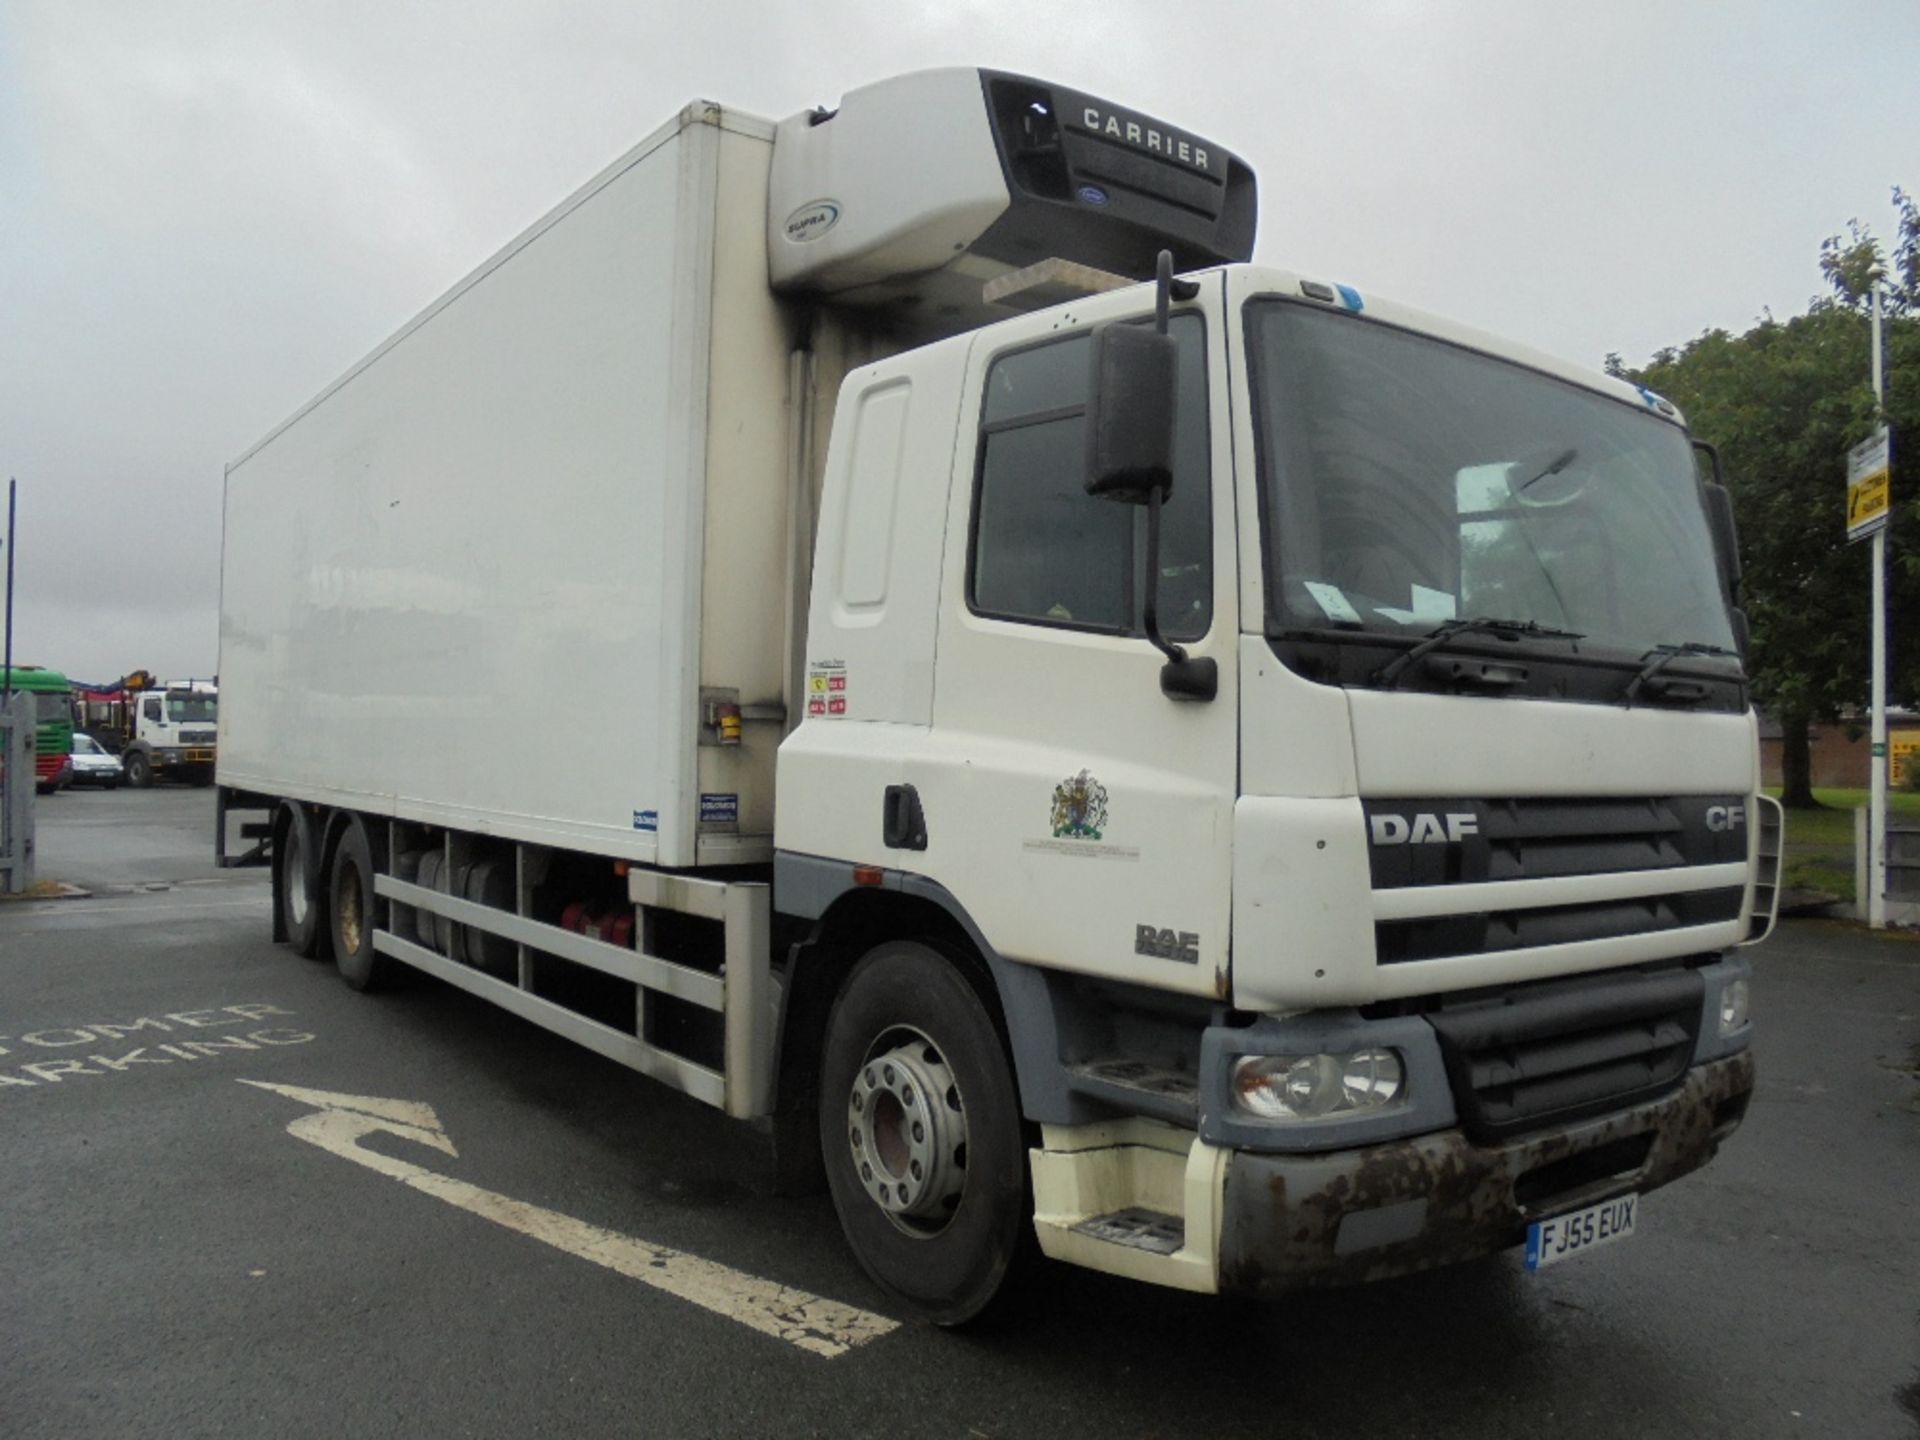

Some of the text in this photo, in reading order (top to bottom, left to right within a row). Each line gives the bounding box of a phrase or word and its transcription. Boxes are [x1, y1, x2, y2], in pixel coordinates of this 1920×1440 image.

[1083, 107, 1209, 169] CARRIER
[787, 212, 826, 233] SUPRA
[1370, 813, 1479, 846] DAF
[1706, 806, 1745, 832] CF
[1136, 923, 1199, 949] DAF
[0, 1003, 297, 1056] OMER
[1541, 1198, 1635, 1259] FJ55 EUX
